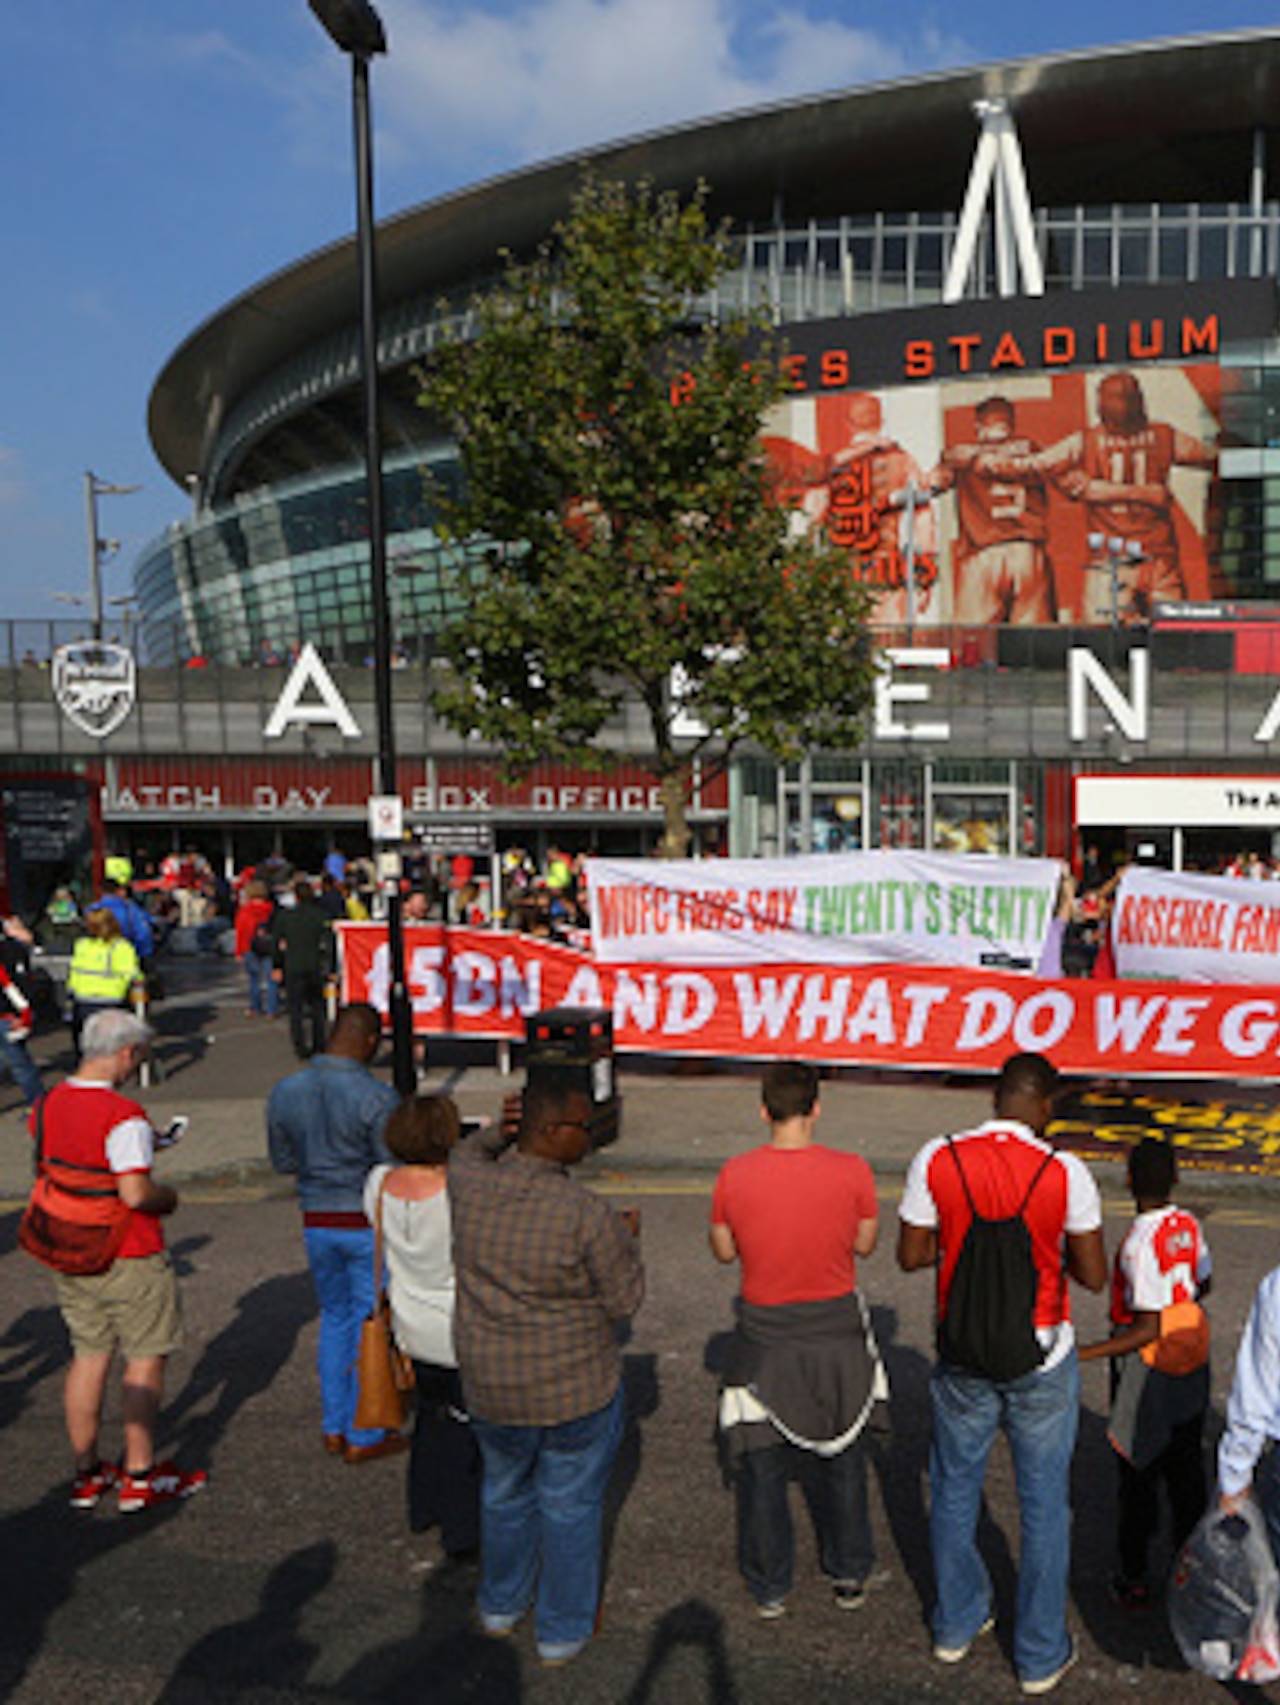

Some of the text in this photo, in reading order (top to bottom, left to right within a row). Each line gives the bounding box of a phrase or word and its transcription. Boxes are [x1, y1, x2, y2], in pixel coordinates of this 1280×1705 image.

[904, 314, 1219, 378] STADIUM
[254, 786, 331, 812] DAY
[412, 785, 492, 811] BOX
[1226, 789, 1260, 808] The
[804, 879, 941, 936] TWENTY'S
[948, 884, 1051, 943] PLENTY
[1118, 892, 1224, 950] ARSENAL
[560, 963, 719, 1037] AND
[732, 972, 949, 1050] WHAT
[956, 988, 1075, 1054] DO
[1094, 994, 1210, 1055] WE
